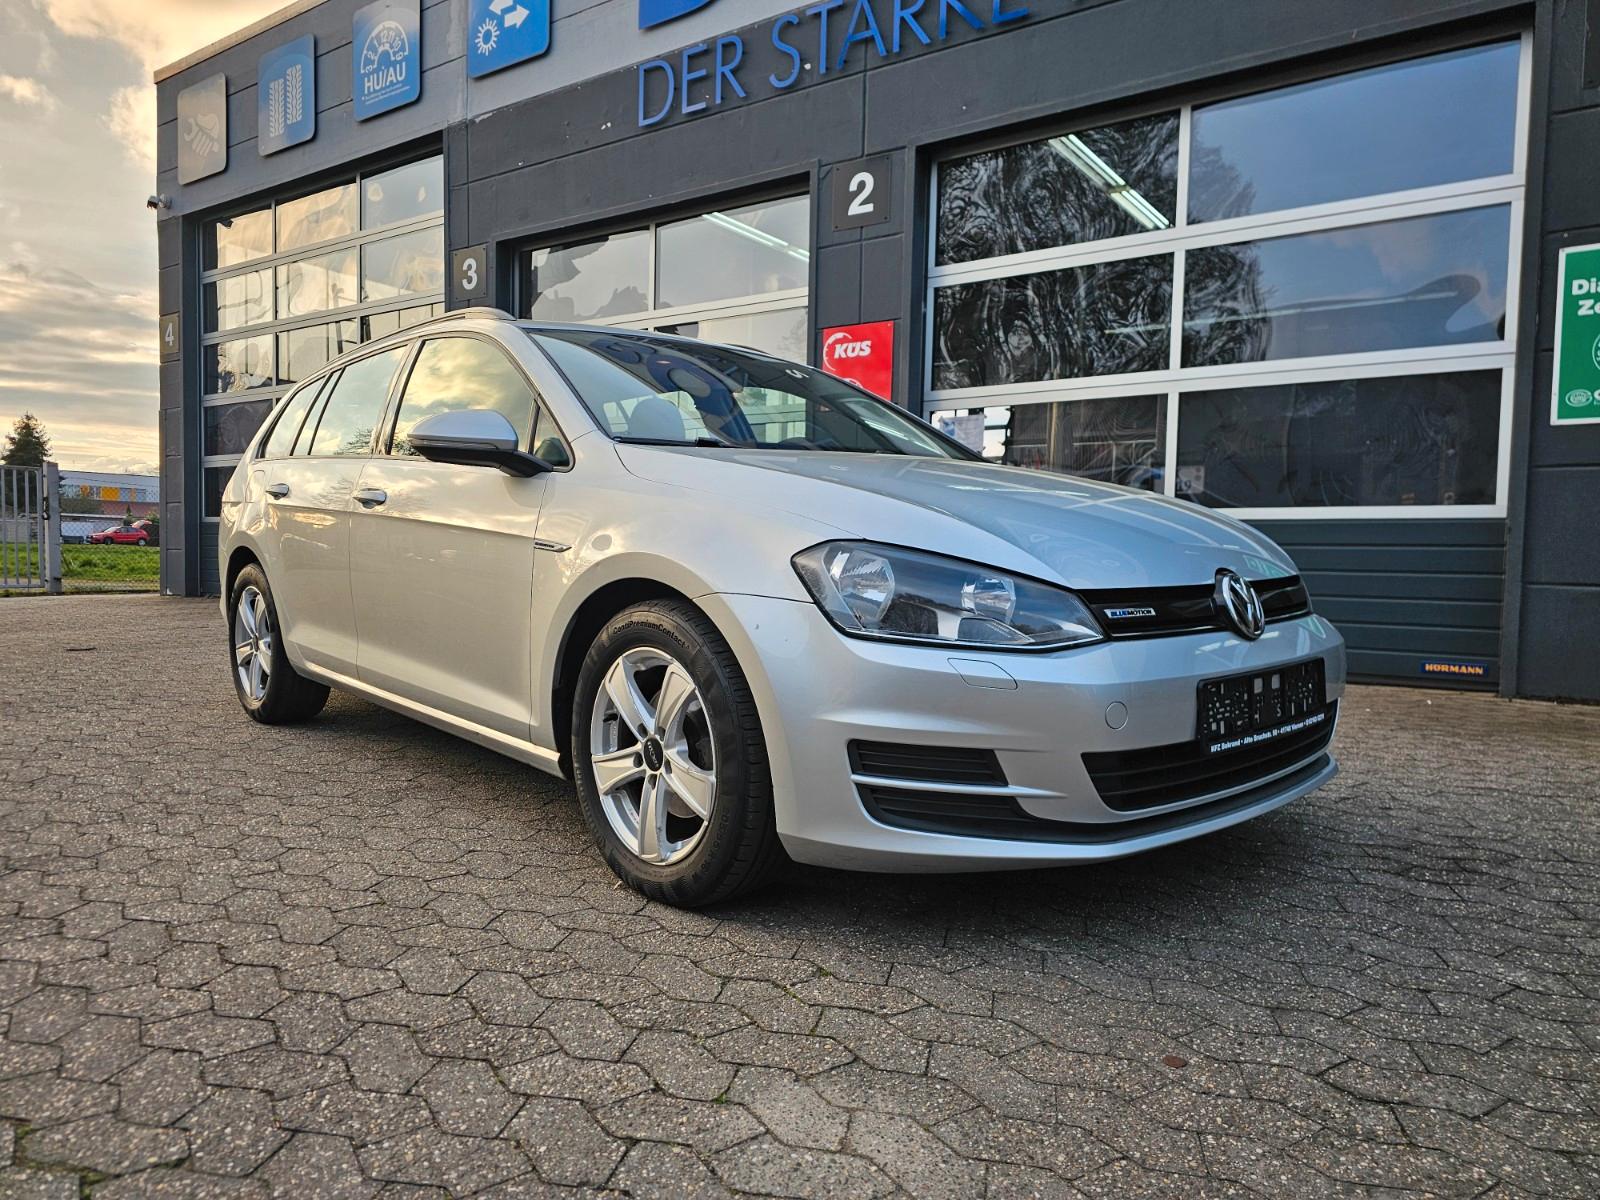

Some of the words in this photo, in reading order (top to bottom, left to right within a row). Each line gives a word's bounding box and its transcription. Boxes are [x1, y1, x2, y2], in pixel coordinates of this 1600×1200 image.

[364, 62, 406, 94] HU/AU
[638, 35, 746, 127] DER
[847, 171, 875, 216] 2
[462, 257, 478, 290] 3
[1572, 278, 1600, 295] Di
[165, 322, 174, 347] 4
